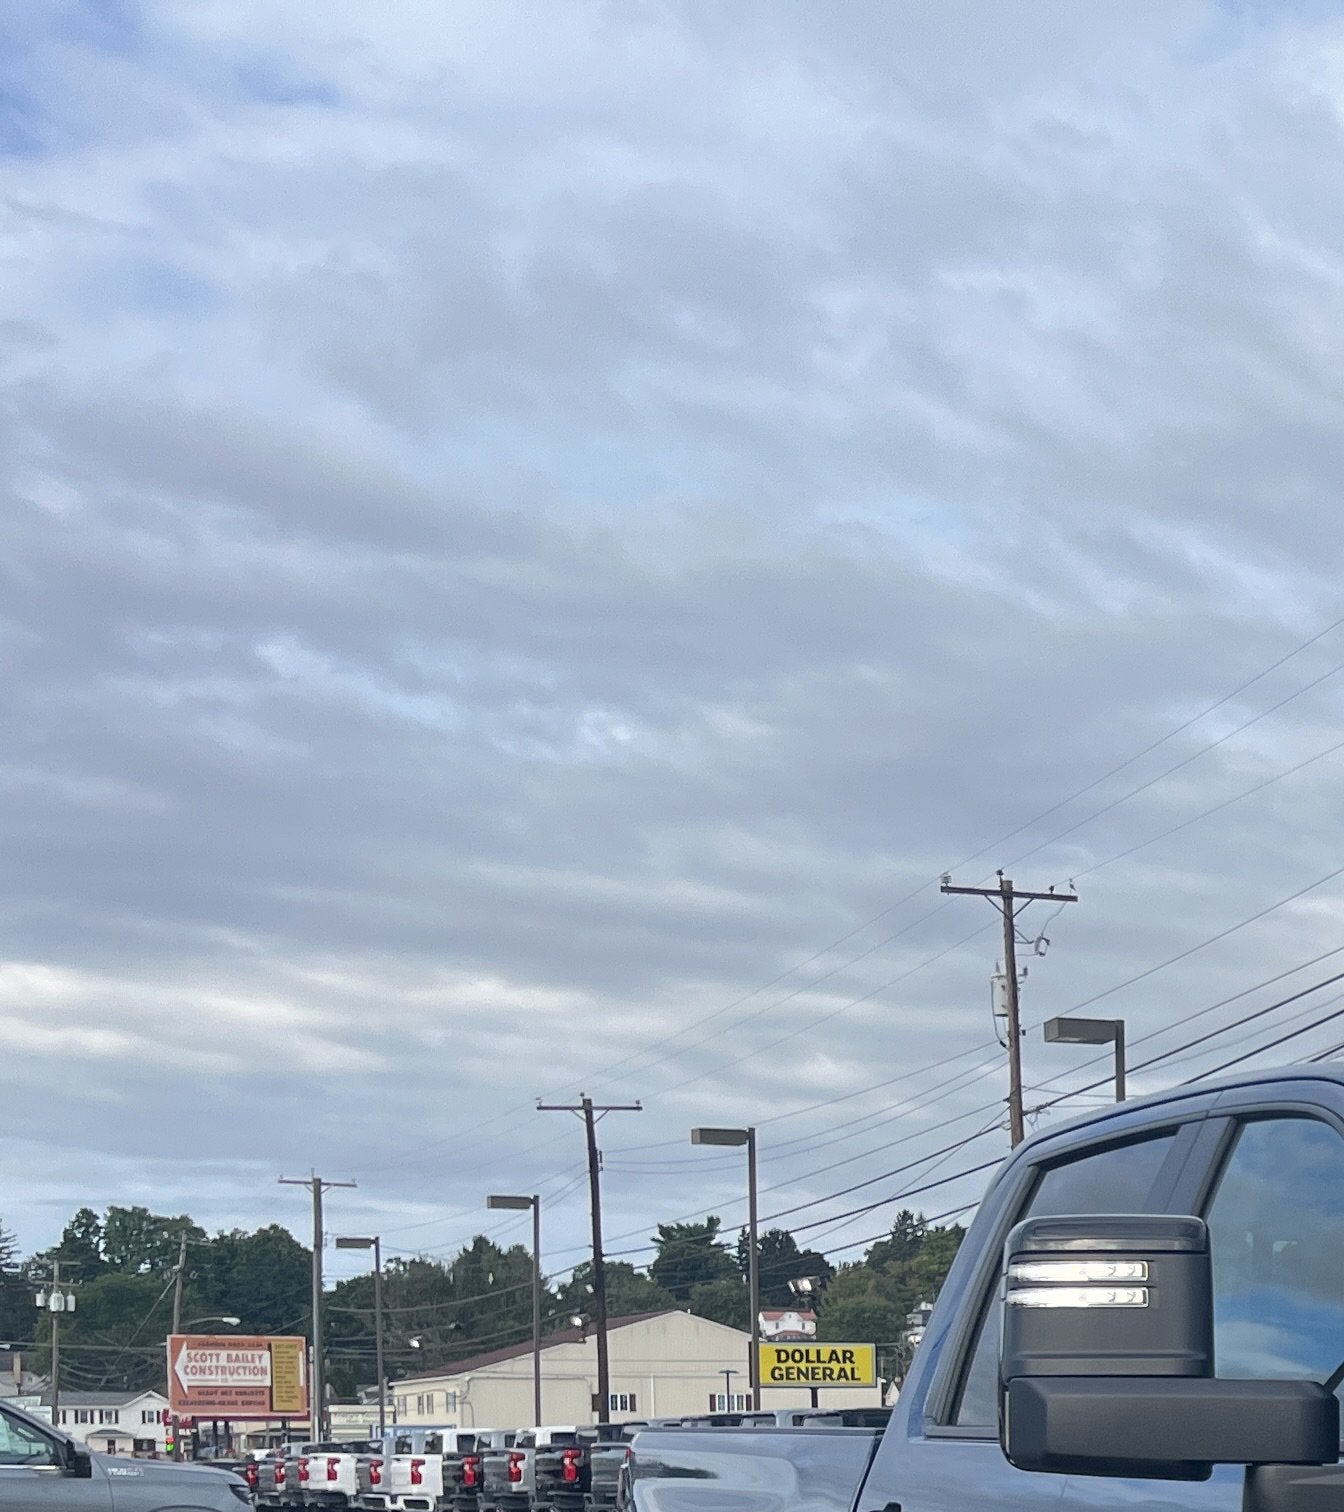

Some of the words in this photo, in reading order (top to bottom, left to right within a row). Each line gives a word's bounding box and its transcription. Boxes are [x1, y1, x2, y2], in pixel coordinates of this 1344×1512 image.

[186, 1351, 221, 1364] SCOTT
[226, 1352, 264, 1364] BAILEY
[775, 1348, 855, 1364] DOLLAR
[183, 1364, 268, 1376] CONSTRUCTION
[770, 1366, 862, 1381] GENERAL
